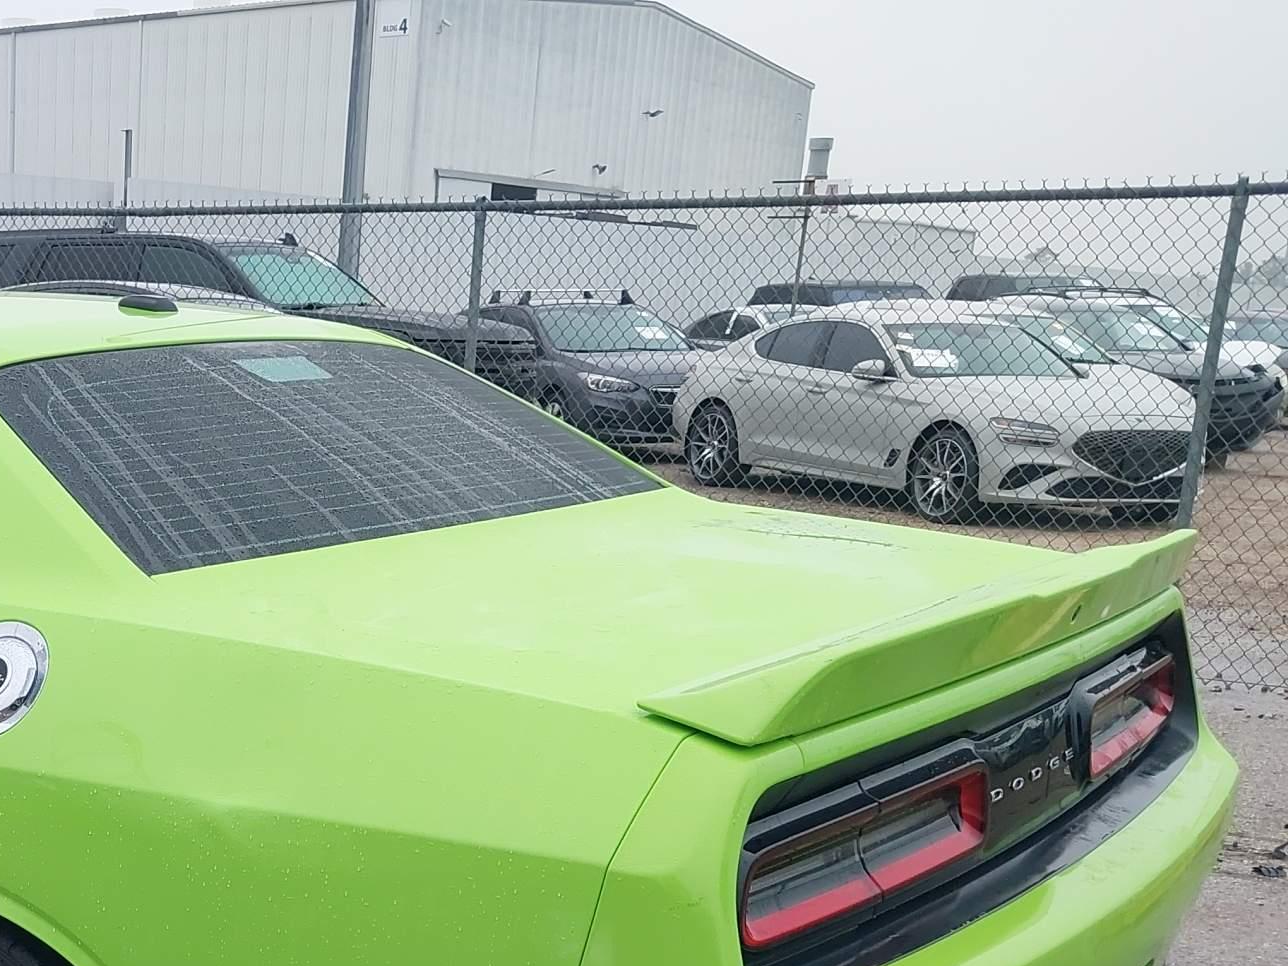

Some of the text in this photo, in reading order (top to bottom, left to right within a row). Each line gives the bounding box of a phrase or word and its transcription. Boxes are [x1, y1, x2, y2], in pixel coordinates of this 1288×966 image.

[383, 18, 409, 34] BLDG 4
[989, 748, 1076, 803] DODGE
